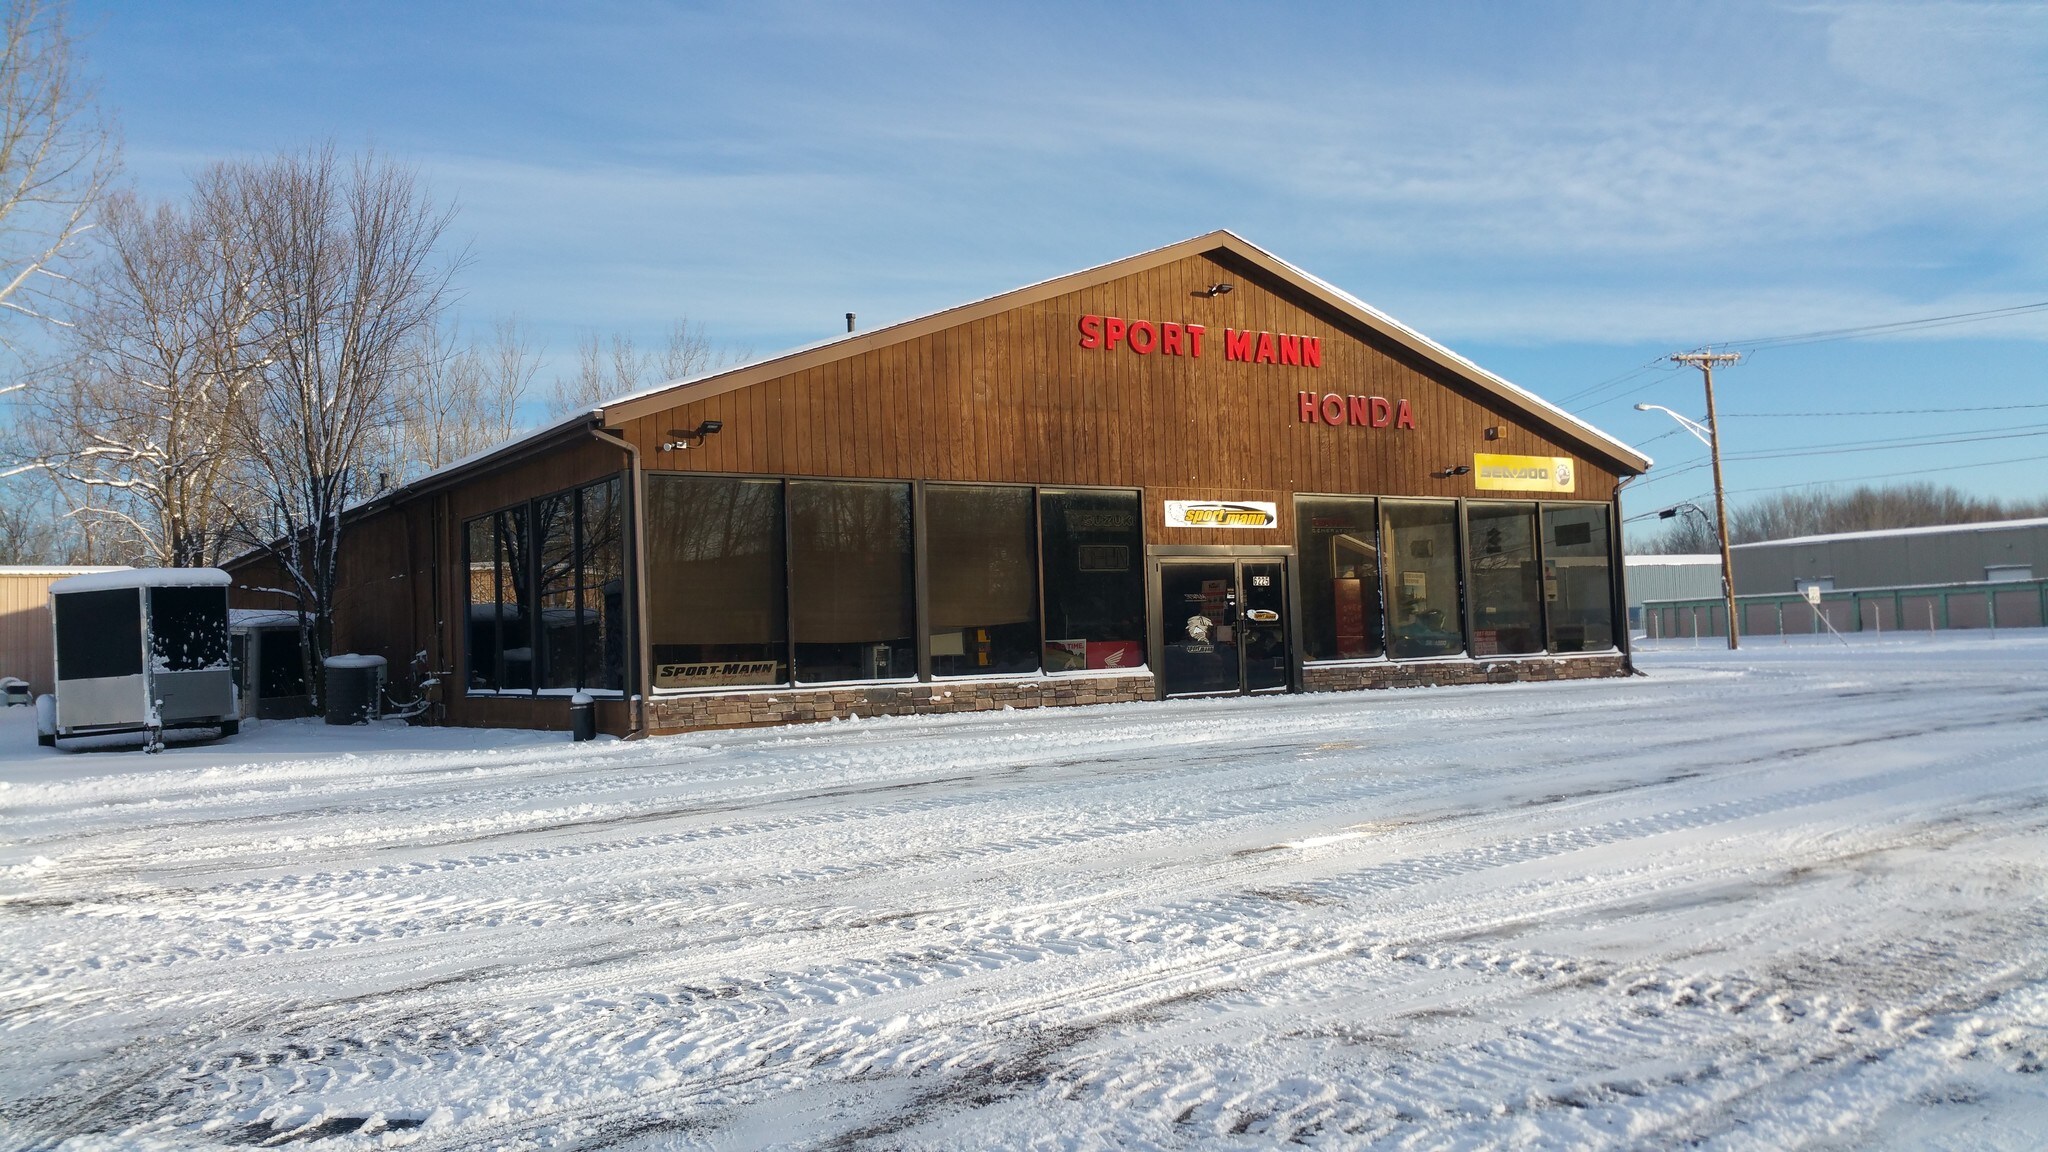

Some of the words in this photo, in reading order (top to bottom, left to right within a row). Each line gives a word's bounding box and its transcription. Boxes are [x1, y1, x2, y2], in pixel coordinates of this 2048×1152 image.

[1078, 314, 1205, 358] SPORT
[1224, 327, 1320, 368] MANN
[1299, 390, 1415, 430] HONDA
[1184, 508, 1226, 525] sport
[1225, 513, 1266, 526] mann
[1253, 576, 1269, 586] 6225
[660, 663, 774, 678] SPORT-MANN
